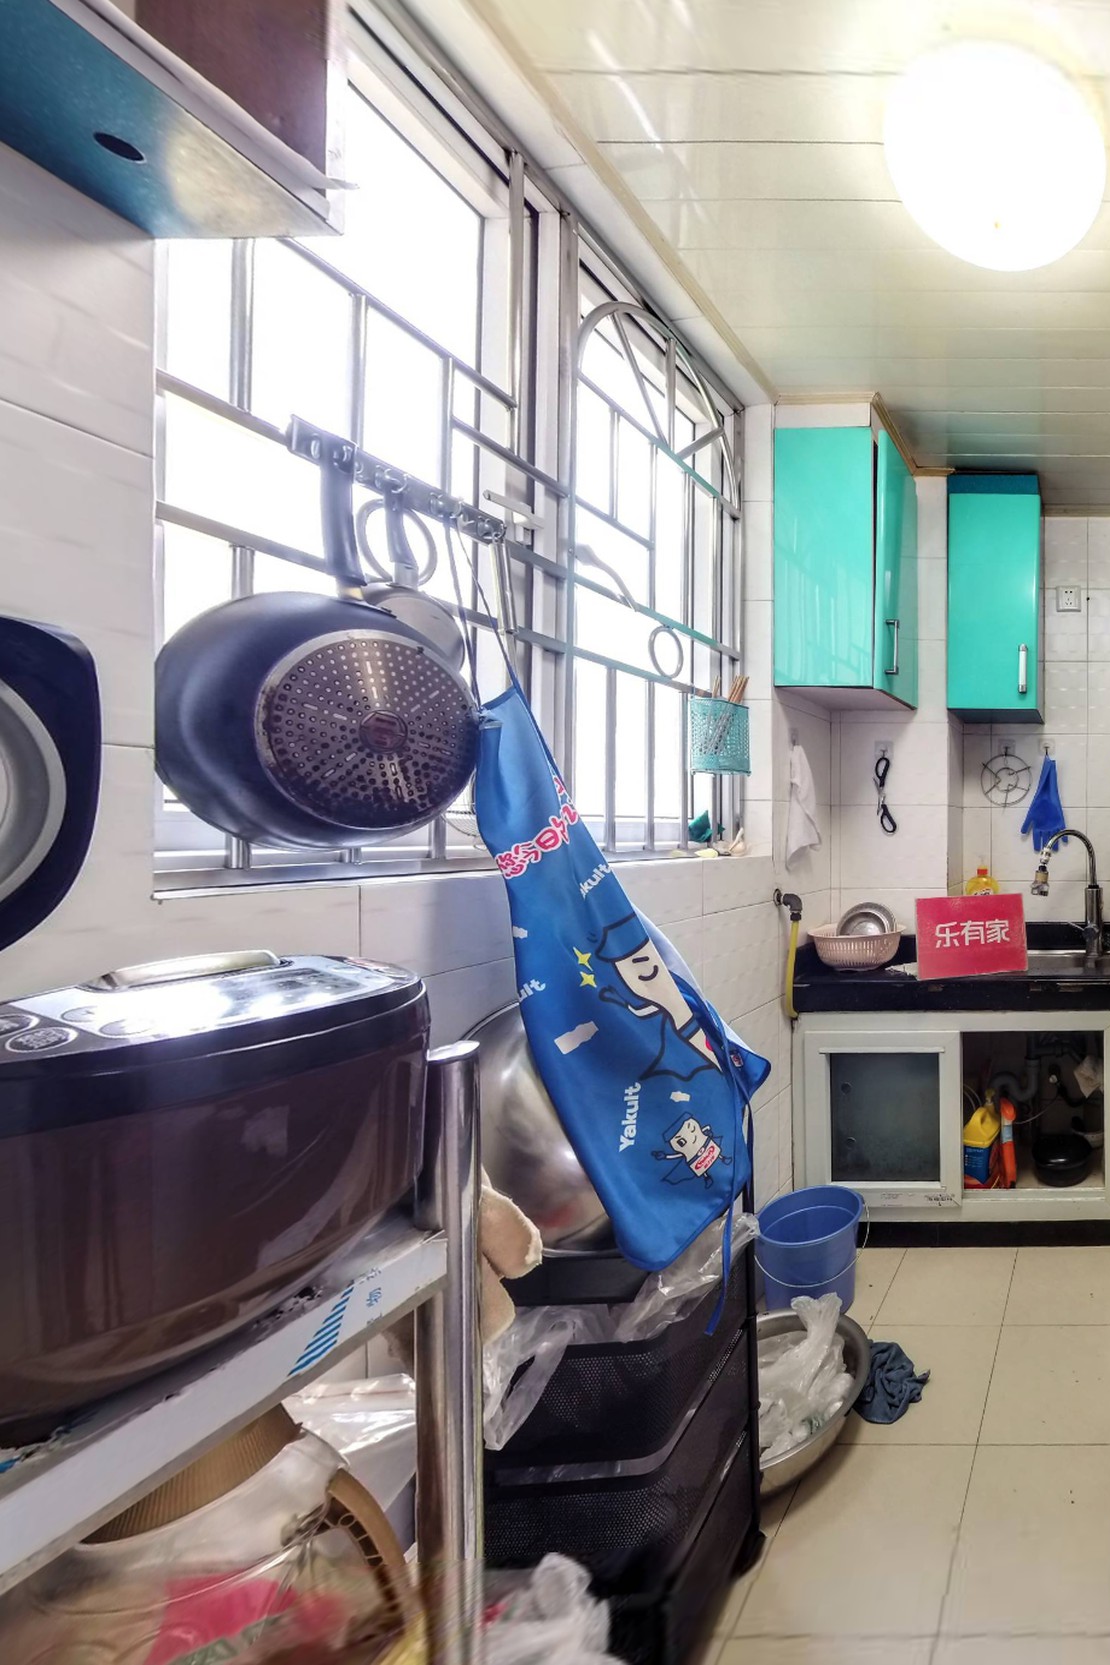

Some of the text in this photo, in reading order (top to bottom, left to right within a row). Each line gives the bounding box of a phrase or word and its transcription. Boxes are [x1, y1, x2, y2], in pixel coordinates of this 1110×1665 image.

[580, 863, 612, 899] kult
[935, 919, 1010, 949] 乐有家
[619, 1082, 642, 1153] Yakult
